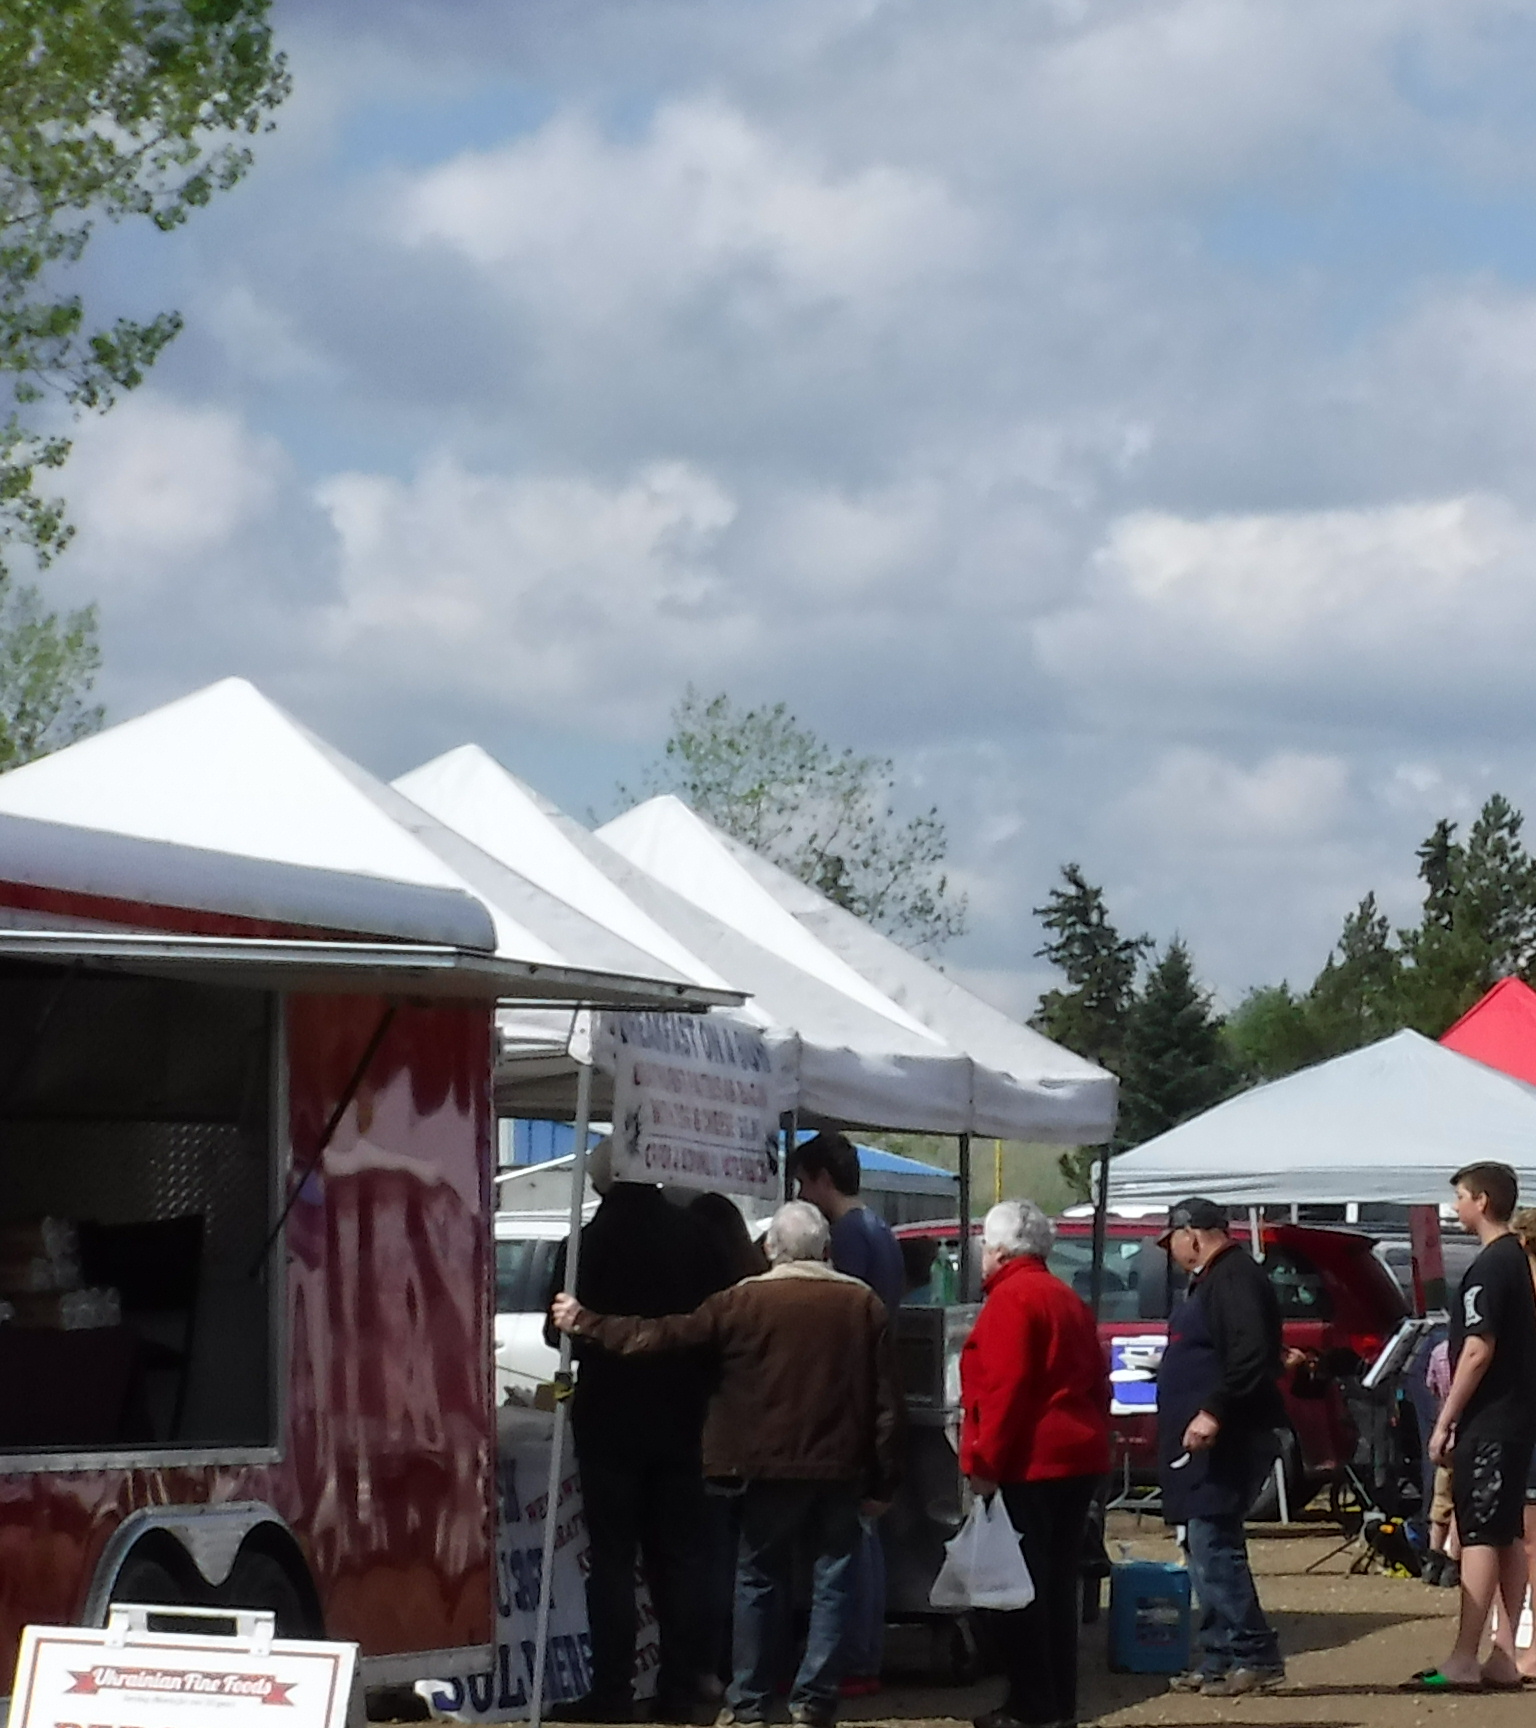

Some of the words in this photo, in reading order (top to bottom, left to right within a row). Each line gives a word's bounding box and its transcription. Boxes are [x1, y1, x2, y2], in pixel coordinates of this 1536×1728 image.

[93, 1667, 181, 1689] Ukrainian
[183, 1672, 220, 1691] Fine
[222, 1675, 272, 1695] Foods
